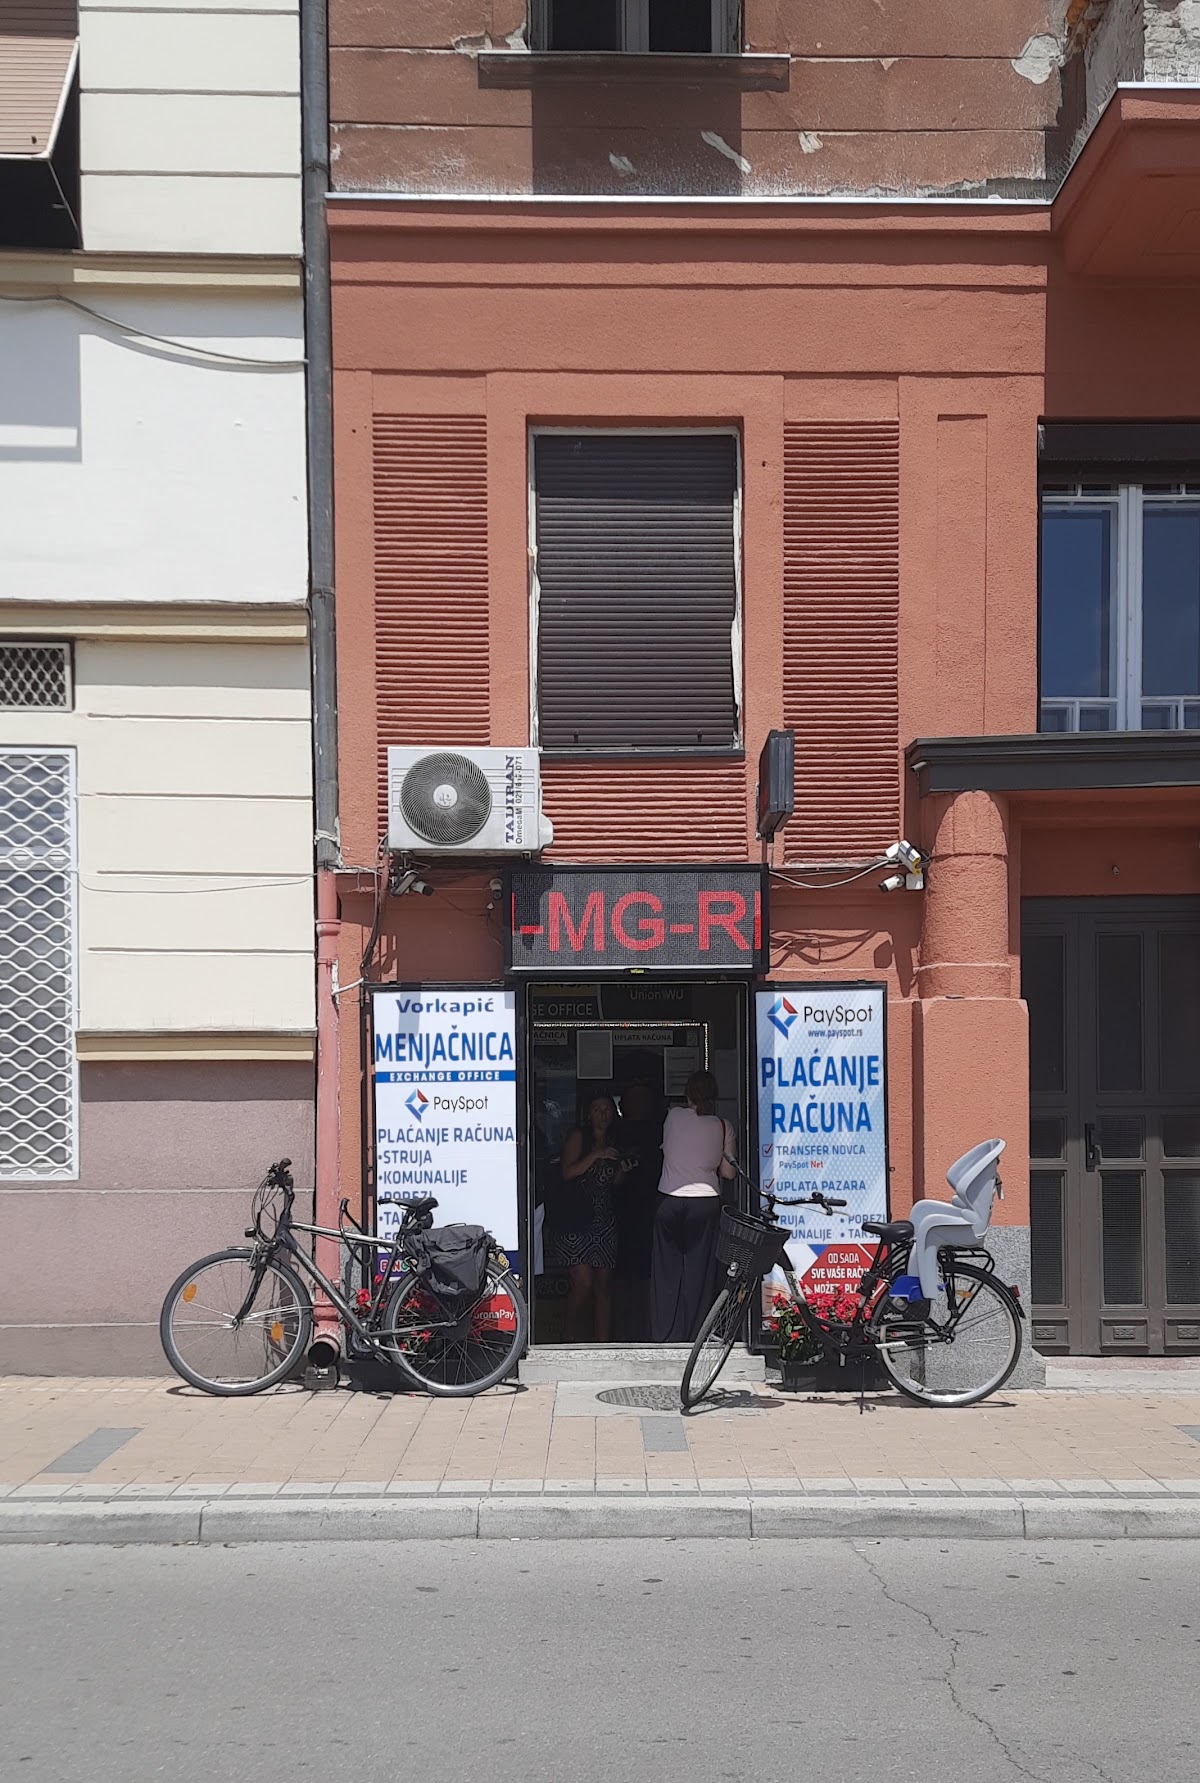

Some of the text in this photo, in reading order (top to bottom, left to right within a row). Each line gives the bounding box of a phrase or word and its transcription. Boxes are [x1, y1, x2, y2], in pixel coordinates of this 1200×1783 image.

[506, 755, 514, 842] TADIRAN
[395, 998, 494, 1016] Vorkapić
[548, 1003, 592, 1016] OFFICE
[804, 1005, 873, 1026] PaySpot
[642, 1033, 672, 1041] RAČUNA
[808, 1029, 863, 1039] www.payspot.rs
[375, 1024, 514, 1069] MENJAČNICA
[390, 1071, 500, 1082] EXCHANGE OFFICE
[761, 1048, 879, 1094] PLAĆANJE
[433, 1096, 488, 1112] PaySpot
[771, 1094, 872, 1133] RAČUNA
[378, 1123, 514, 1146] PLAĆANJE RAČUNA
[776, 1144, 866, 1155] TRANSFER NOVCA
[384, 1150, 432, 1167] STRUJA
[779, 1160, 824, 1170] PaySpot Net
[384, 1169, 468, 1187] KOMUNALIJE
[776, 1181, 866, 1192] UPLATA PAZARA
[828, 1253, 860, 1264] OD SADA
[811, 1268, 826, 1279] SVE
[826, 1266, 846, 1279] VAŠE
